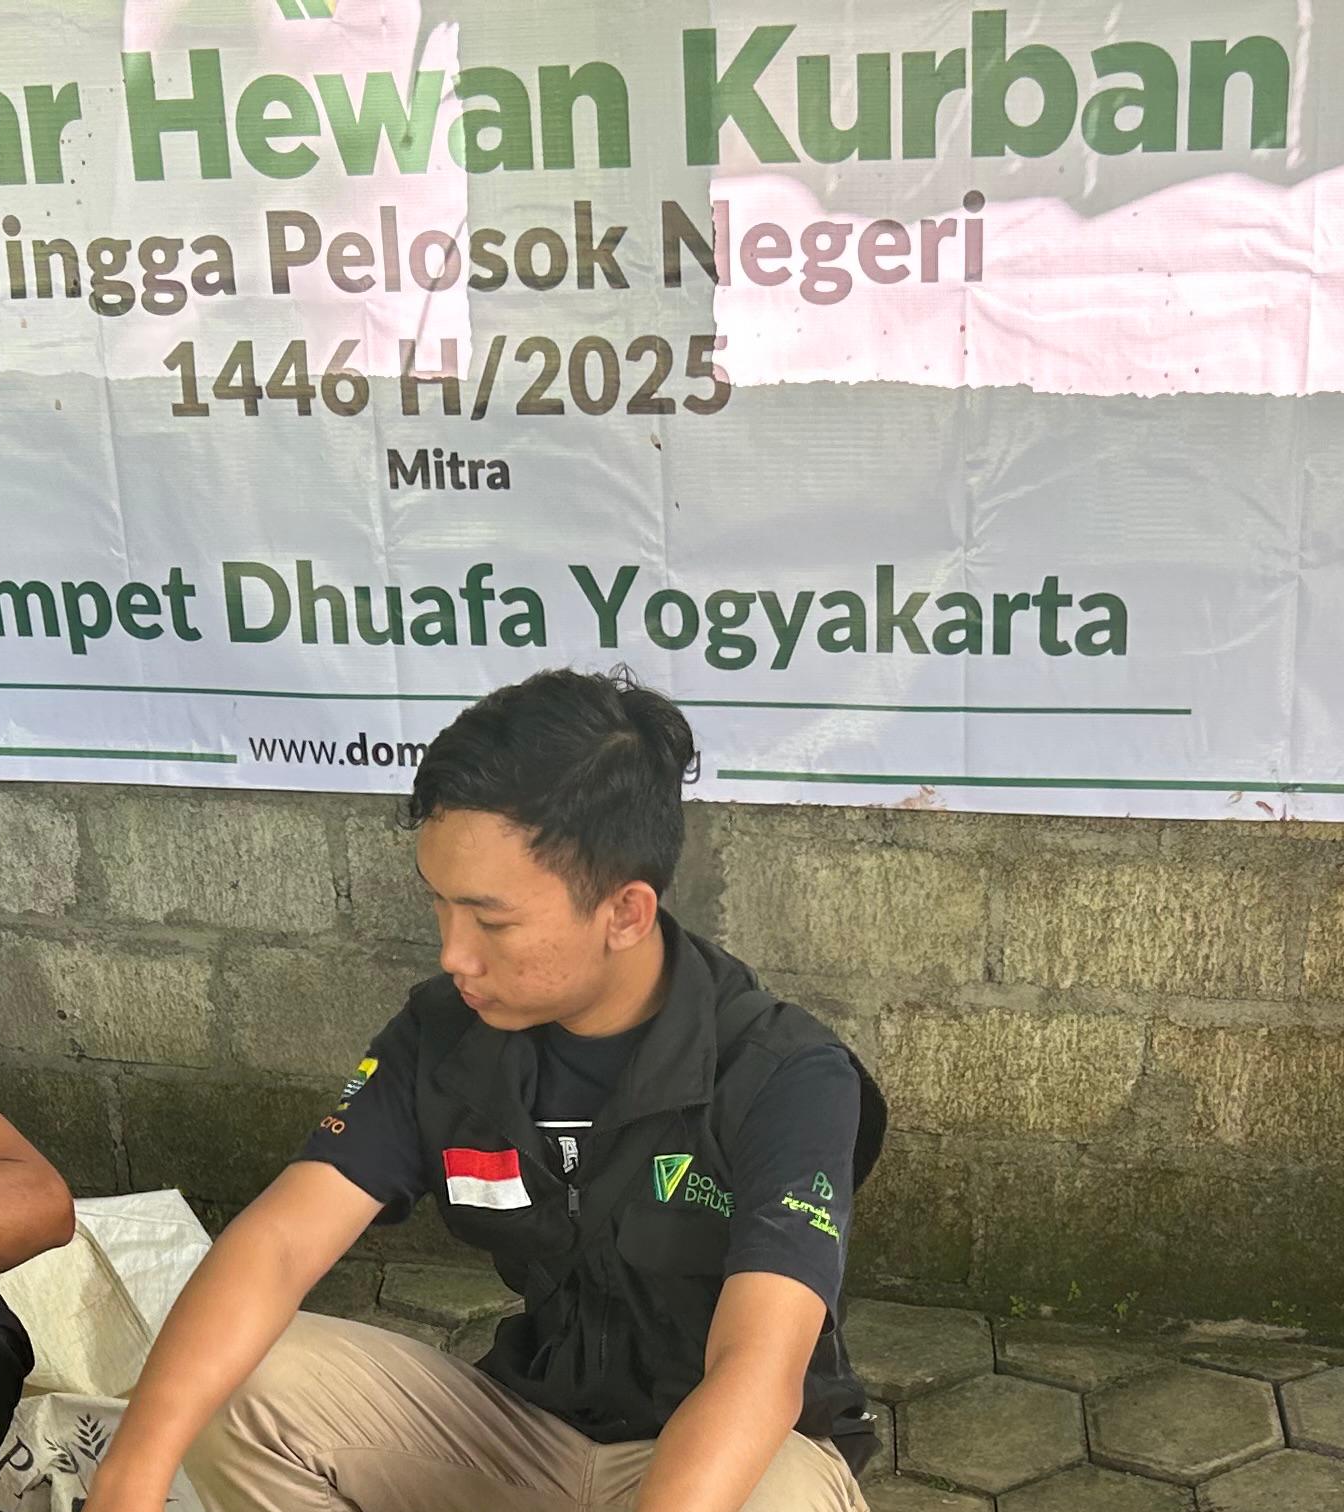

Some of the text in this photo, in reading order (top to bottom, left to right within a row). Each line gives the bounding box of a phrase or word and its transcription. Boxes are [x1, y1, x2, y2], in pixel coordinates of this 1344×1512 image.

[121, 46, 632, 185] Hewan
[683, 10, 1291, 167] Kurban
[269, 204, 626, 298] Pelosok
[662, 189, 986, 305] Negeri
[164, 331, 732, 422] 1446 H/2025
[387, 447, 511, 493] Mitra
[225, 558, 550, 648] Dhuafa
[567, 562, 1131, 673] Yogyakarta
